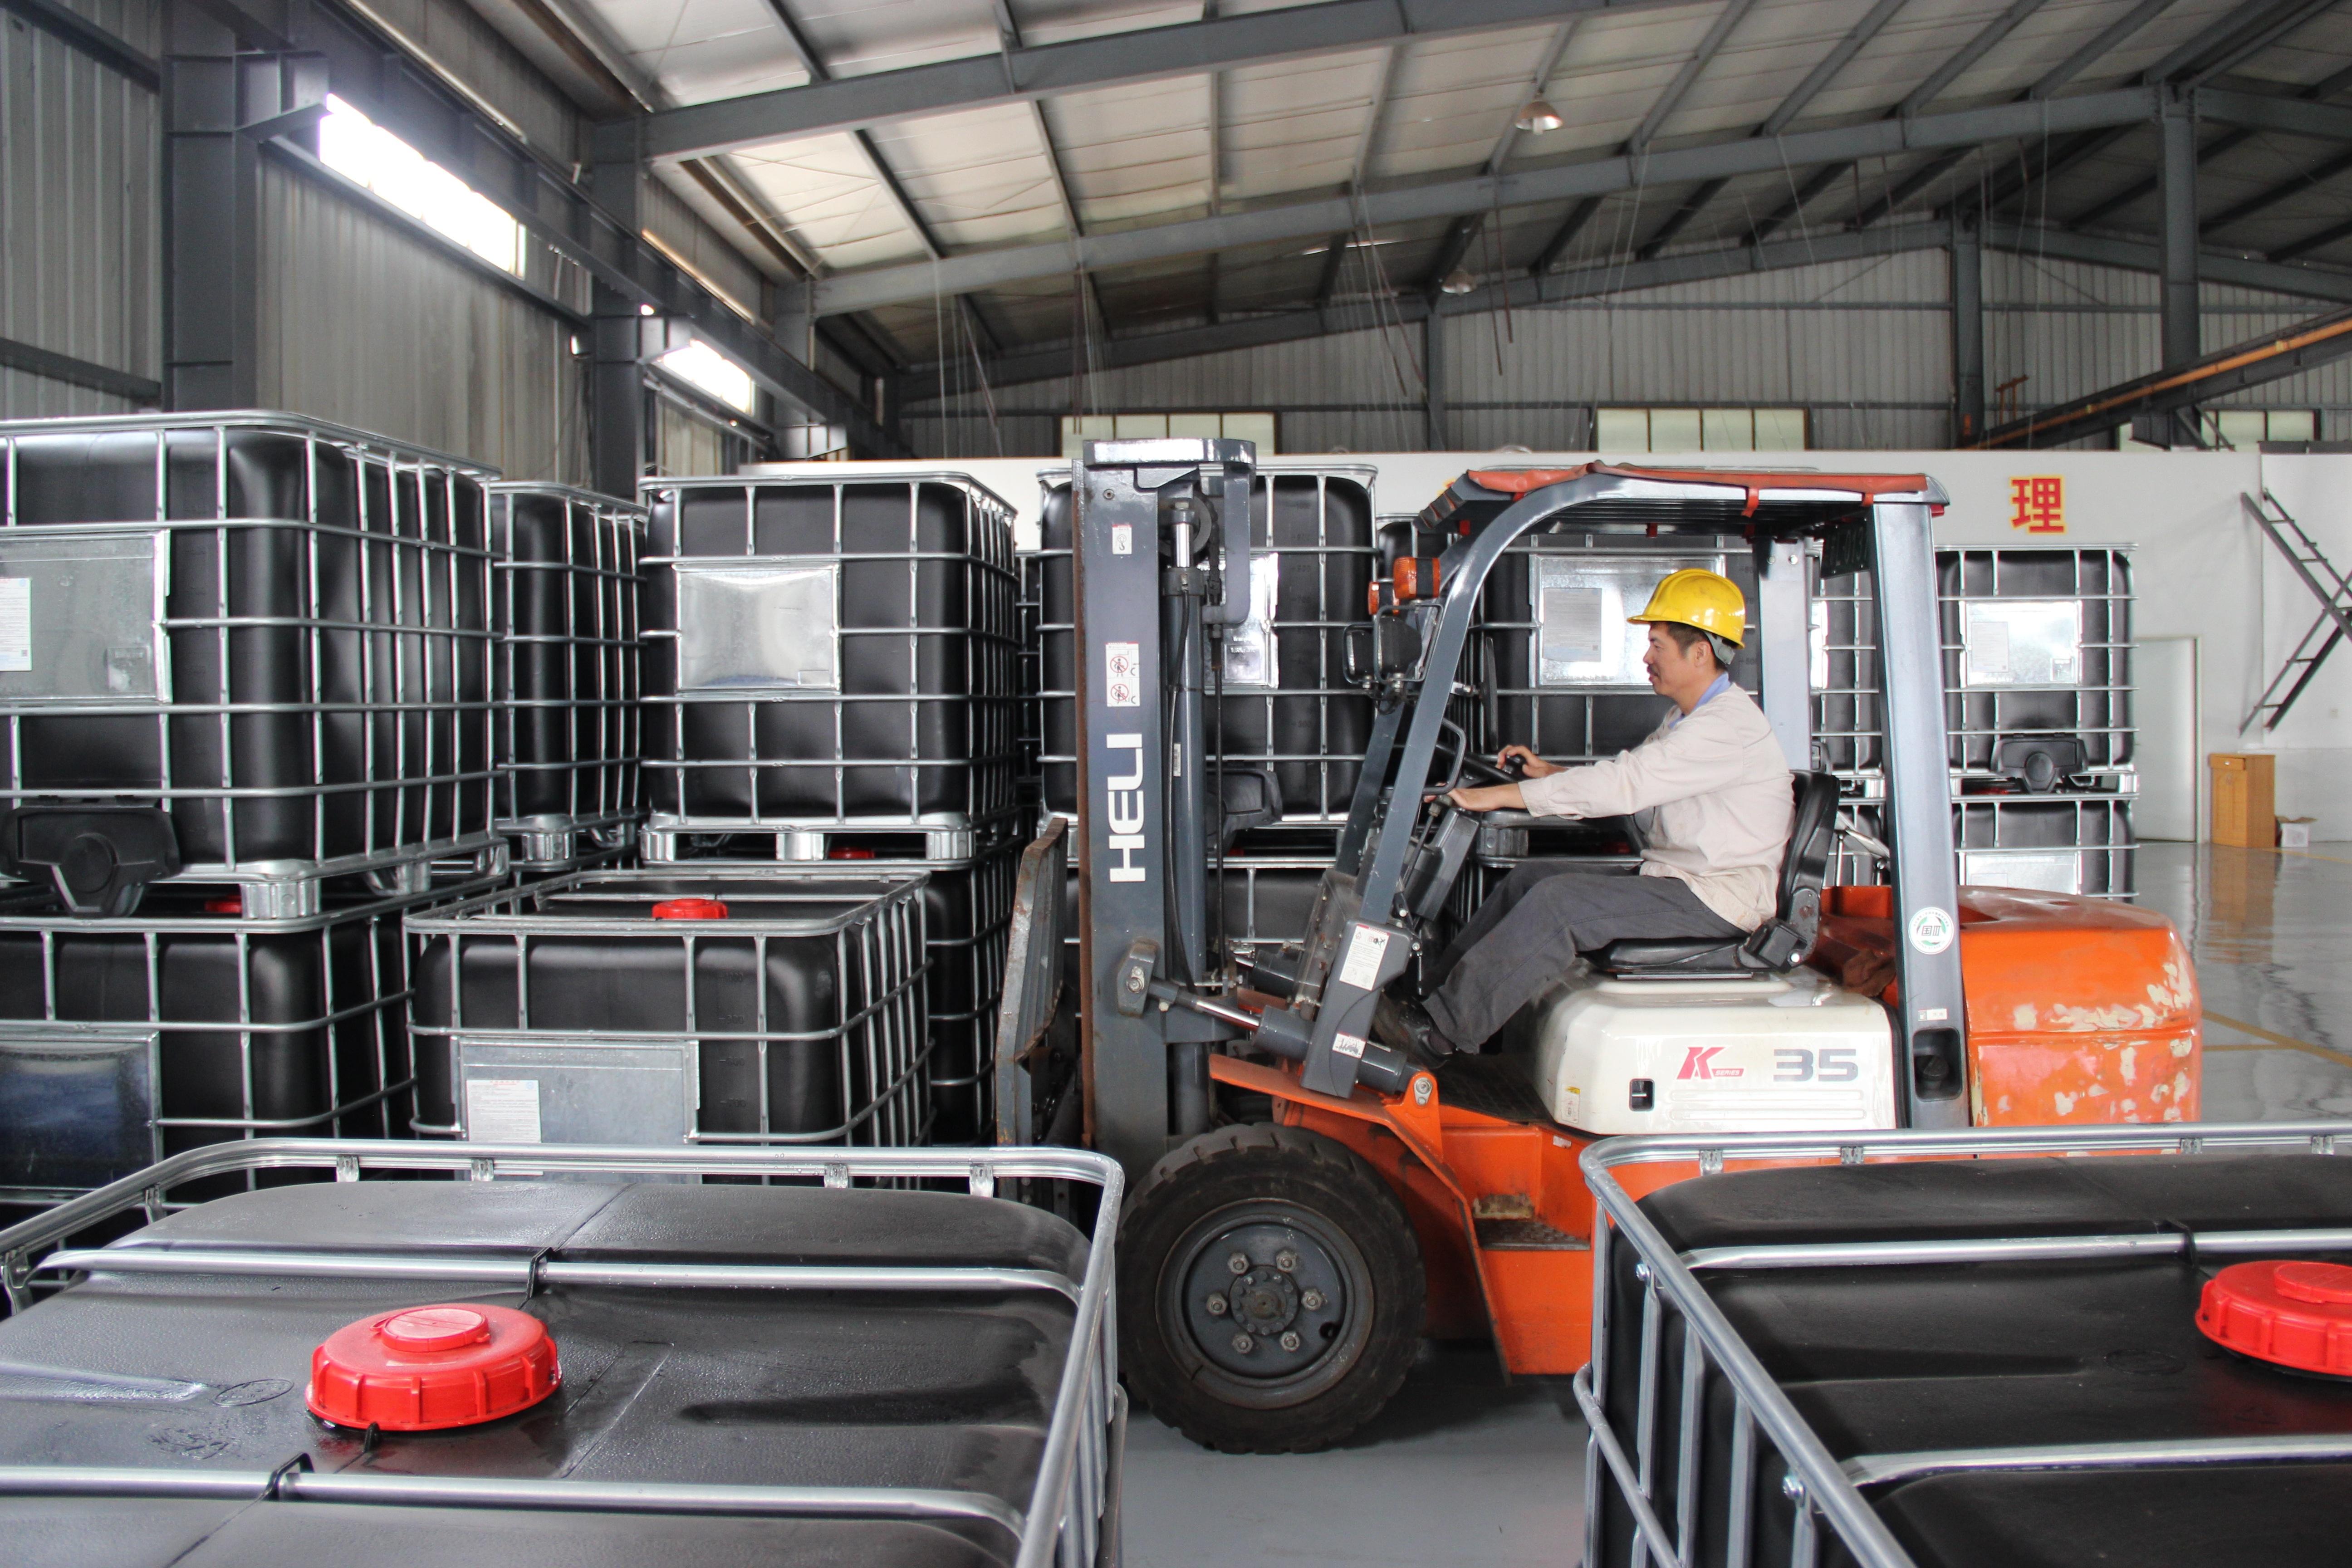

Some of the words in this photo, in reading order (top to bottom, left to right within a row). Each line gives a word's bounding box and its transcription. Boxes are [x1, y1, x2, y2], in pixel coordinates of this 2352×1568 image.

[2009, 475, 2067, 534] 理
[1107, 733, 1146, 882] HELI
[1676, 1046, 1725, 1080] K
[1773, 1049, 1858, 1082] 35
